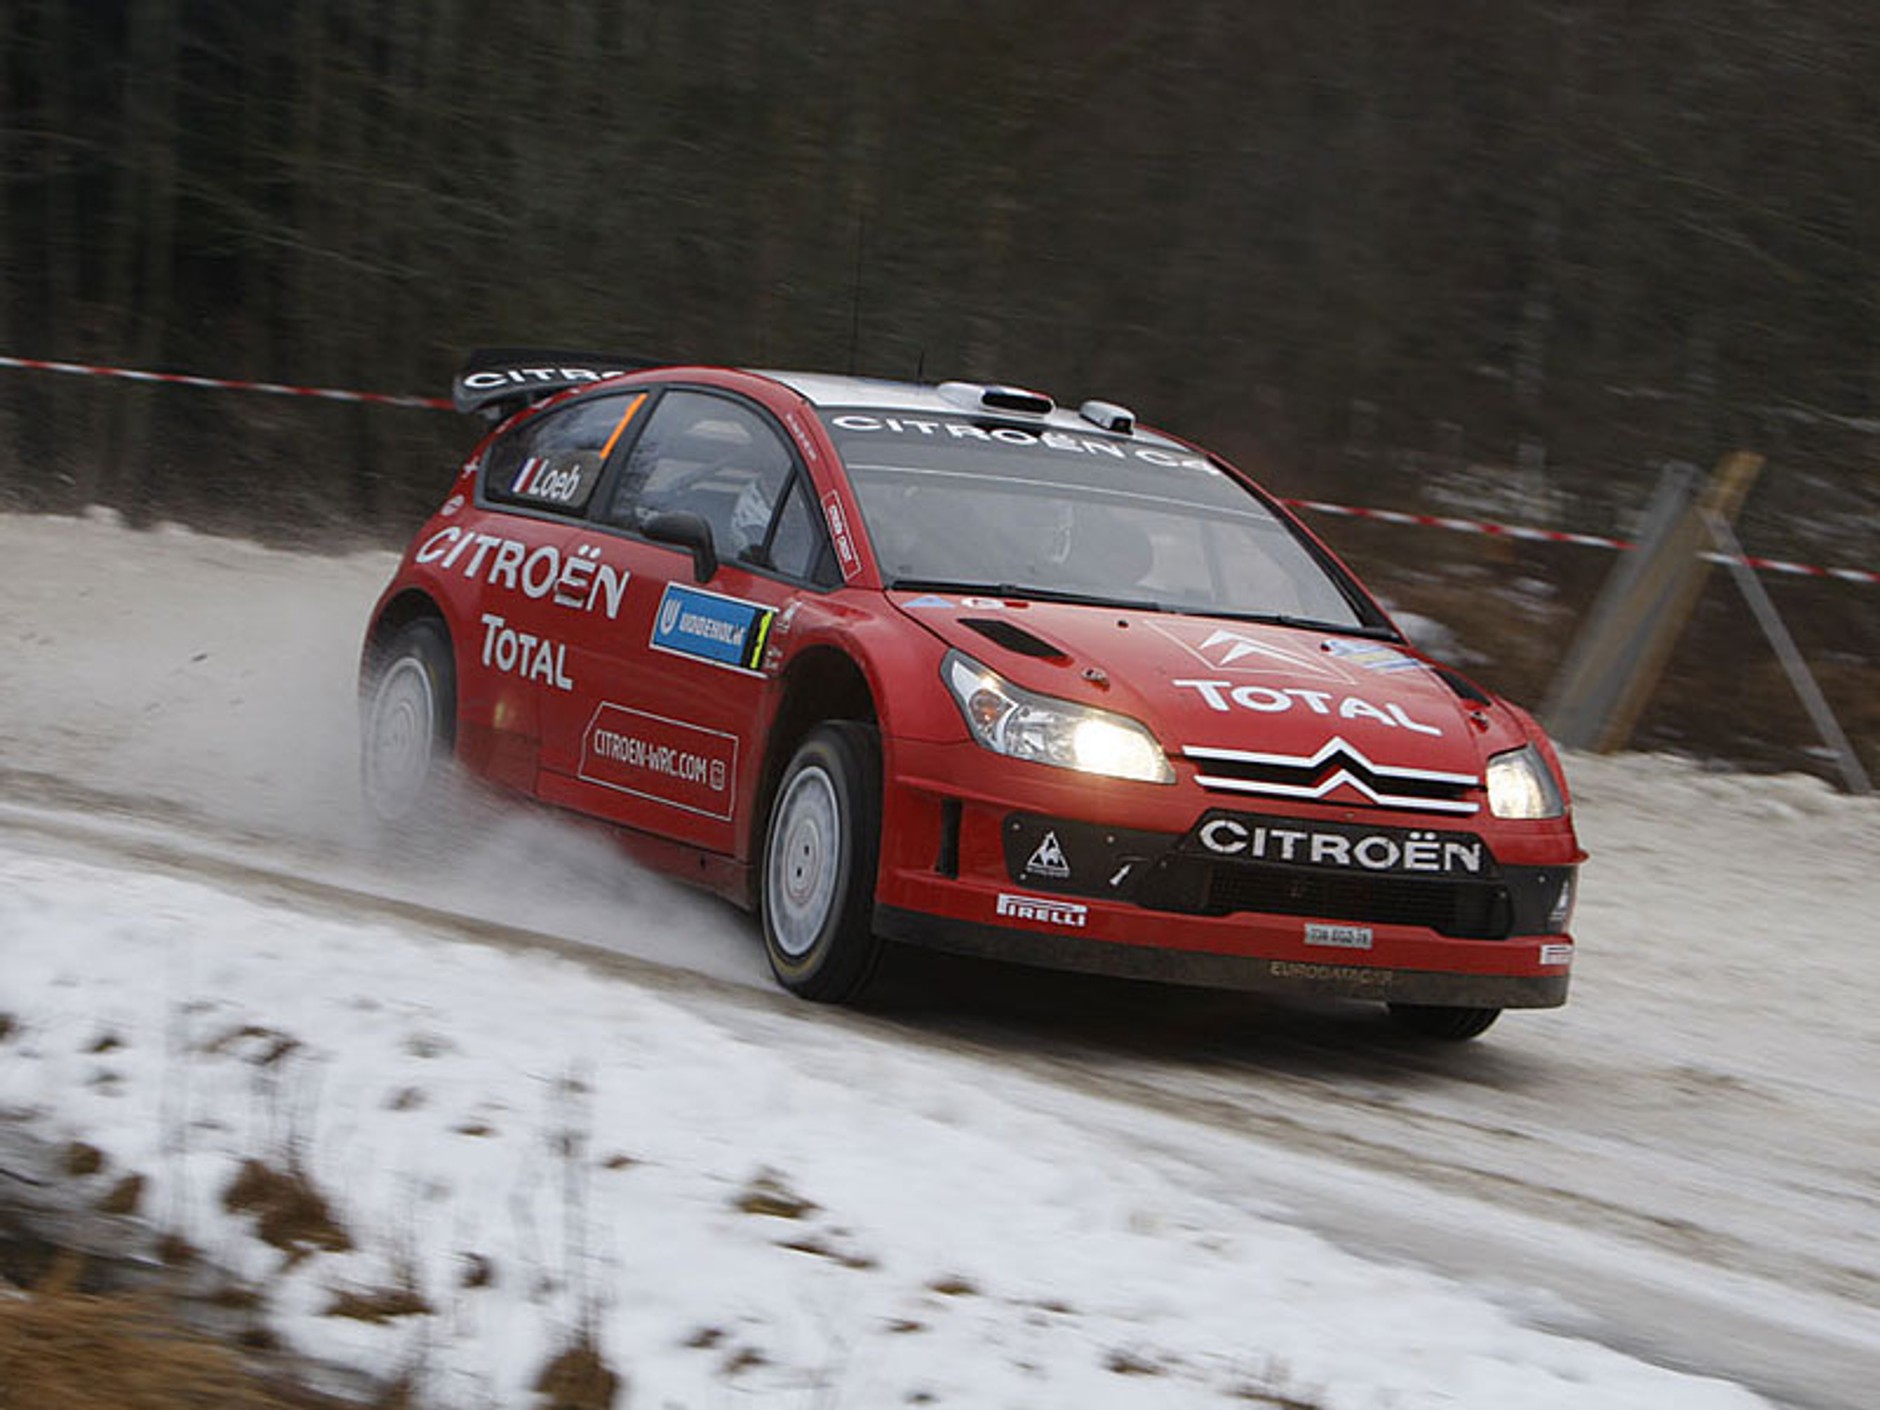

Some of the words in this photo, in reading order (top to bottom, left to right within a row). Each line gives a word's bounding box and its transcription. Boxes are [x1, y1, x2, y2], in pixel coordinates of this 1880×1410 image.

[831, 415, 1128, 460] CITROËN
[528, 458, 581, 500] Loeb
[415, 526, 631, 620] CITROËN
[481, 612, 574, 691] TOTAL
[1171, 678, 1443, 737] TOTAL
[1199, 819, 1482, 872] CITROËN
[996, 892, 1088, 928] PIRELLI
